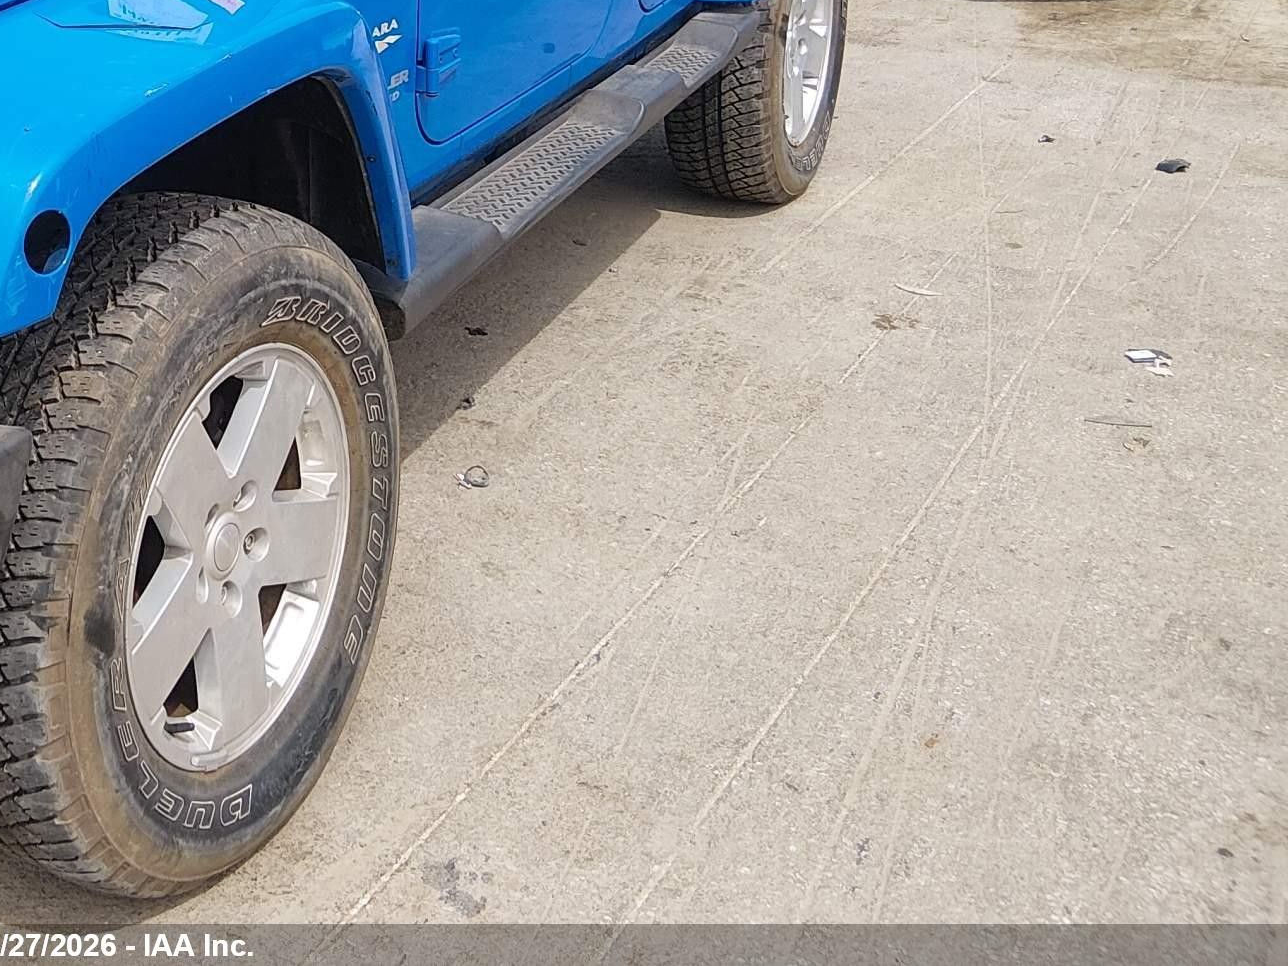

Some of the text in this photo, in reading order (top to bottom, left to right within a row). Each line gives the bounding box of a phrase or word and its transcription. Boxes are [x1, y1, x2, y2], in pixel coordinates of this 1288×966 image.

[371, 18, 399, 38] ARA
[261, 296, 390, 666] BRIDGESTONE
[110, 656, 253, 830] DUELER
